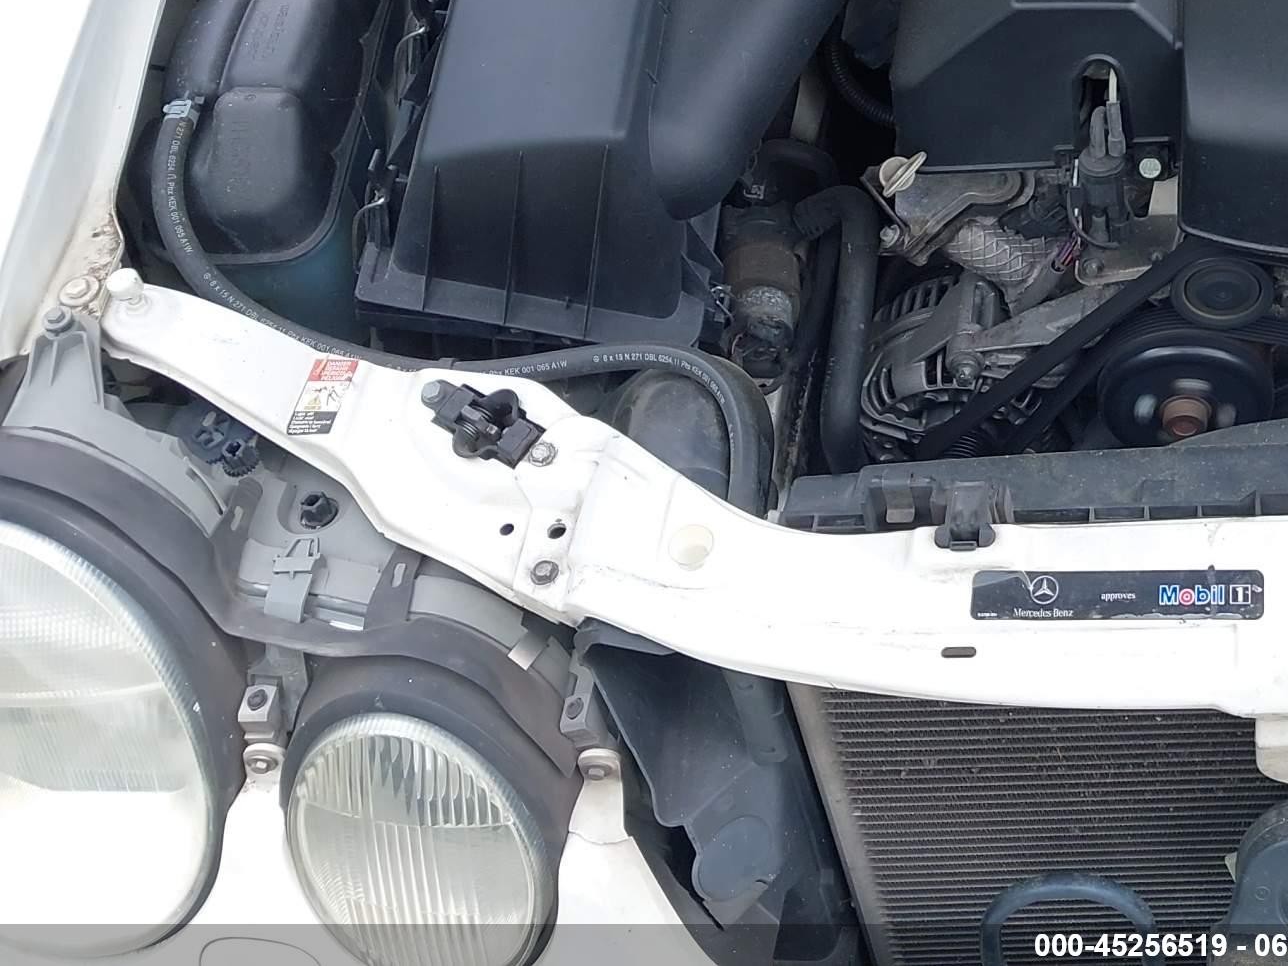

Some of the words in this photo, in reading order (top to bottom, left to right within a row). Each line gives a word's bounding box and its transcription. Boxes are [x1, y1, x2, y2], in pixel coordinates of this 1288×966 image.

[631, 353, 643, 361] 271
[1100, 591, 1136, 602] approves
[1158, 585, 1226, 606] Mobil
[1013, 608, 1052, 618] Mercedes
[1053, 608, 1074, 618] Benz
